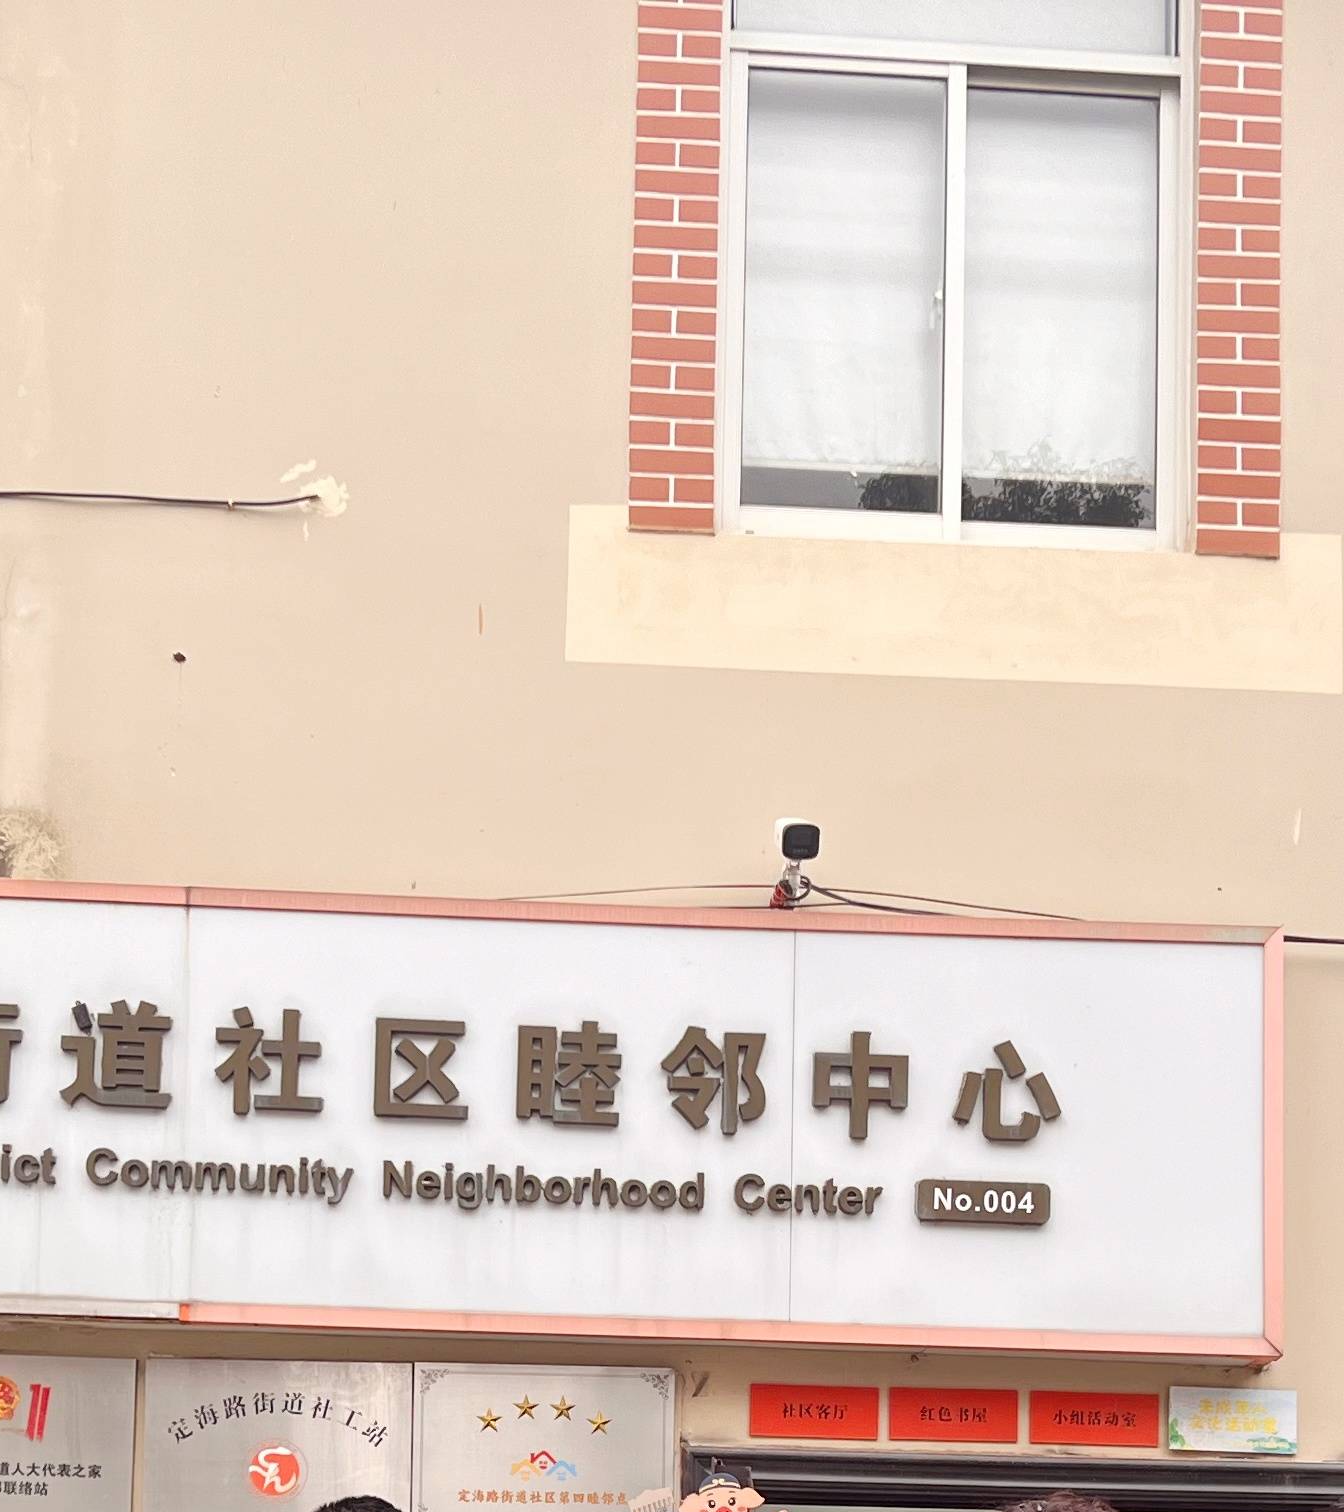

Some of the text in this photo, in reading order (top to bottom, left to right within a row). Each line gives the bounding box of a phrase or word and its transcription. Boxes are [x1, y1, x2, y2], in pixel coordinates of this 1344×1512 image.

[85, 1147, 354, 1206] Community
[382, 1159, 707, 1214] Neighborhood
[733, 1172, 886, 1218] Center
[932, 1186, 1036, 1215] No.004
[167, 1391, 389, 1448] 定海路街道社工站
[782, 1402, 849, 1421] 社区客厅
[919, 1405, 987, 1424] 红色书屋
[1052, 1408, 1138, 1428] 小组活动室
[457, 1488, 629, 1505] 定海路街道社区第四睦邻点
